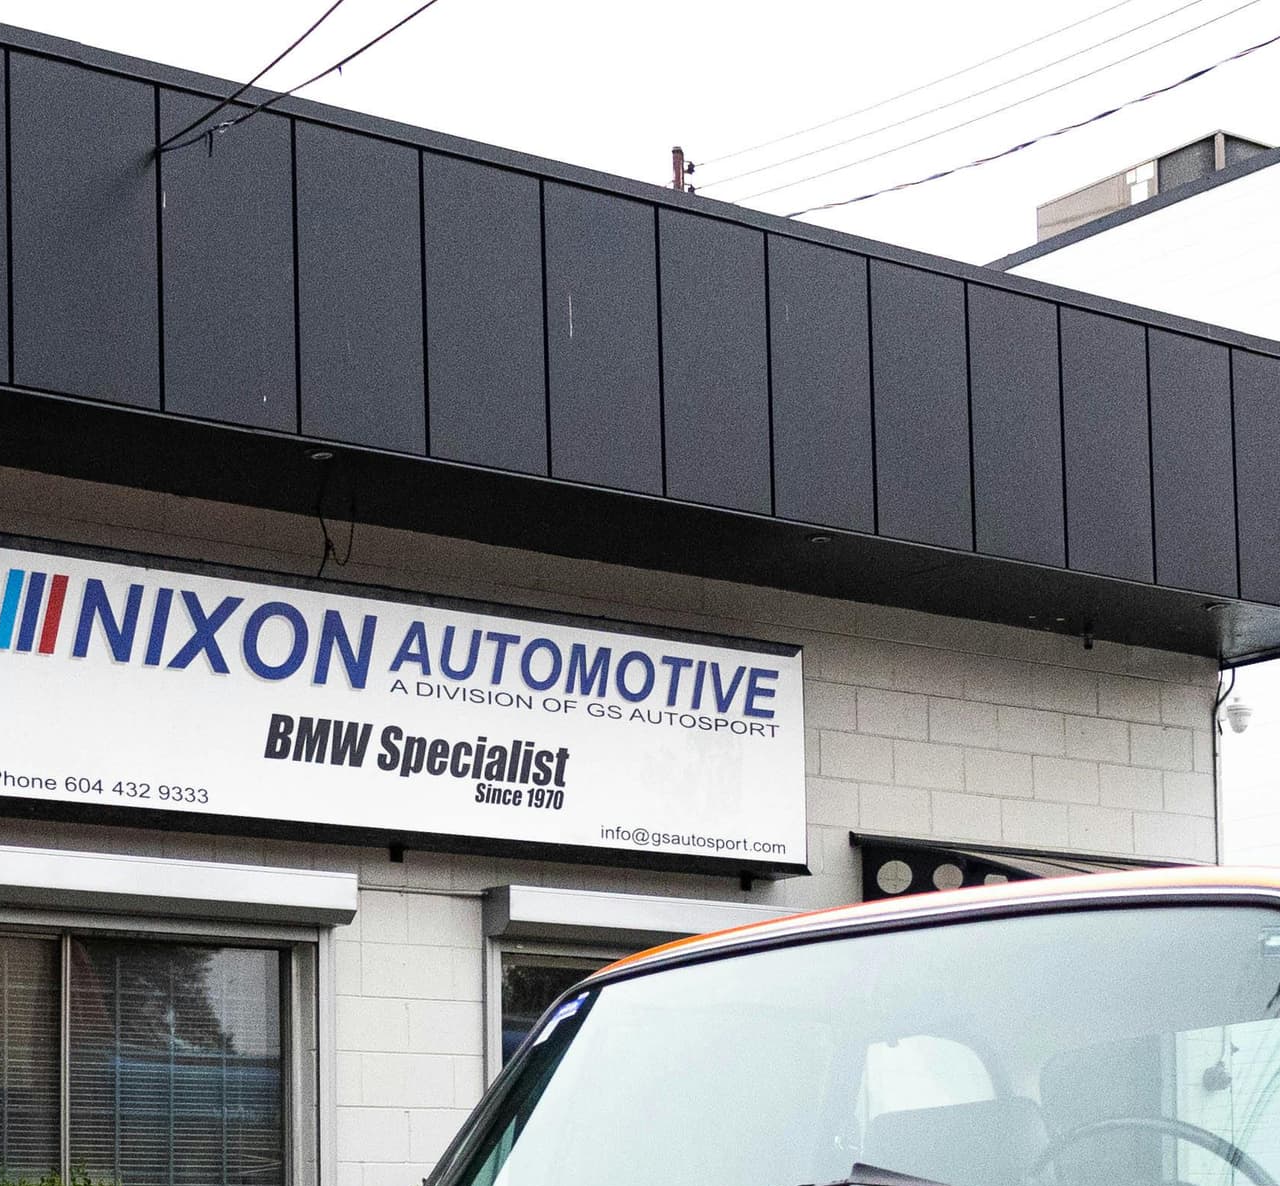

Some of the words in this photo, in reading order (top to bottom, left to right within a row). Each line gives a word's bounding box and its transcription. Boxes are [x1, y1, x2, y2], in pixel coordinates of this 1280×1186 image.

[71, 578, 378, 690] NIXON
[388, 620, 780, 719] AUTOMOTIVE
[389, 679, 409, 695] A
[416, 681, 533, 710] DIVISION
[542, 697, 578, 714] OF
[586, 702, 623, 720] GS
[628, 707, 781, 738] AUTOSPORT
[263, 713, 374, 768] BMW
[376, 724, 570, 788] Specialist
[64, 776, 104, 795] 604
[111, 781, 151, 799] 432
[158, 785, 210, 804] 9333
[474, 782, 523, 807] Since
[526, 787, 565, 811] 1970
[600, 824, 787, 855] info@gsautosport.com
